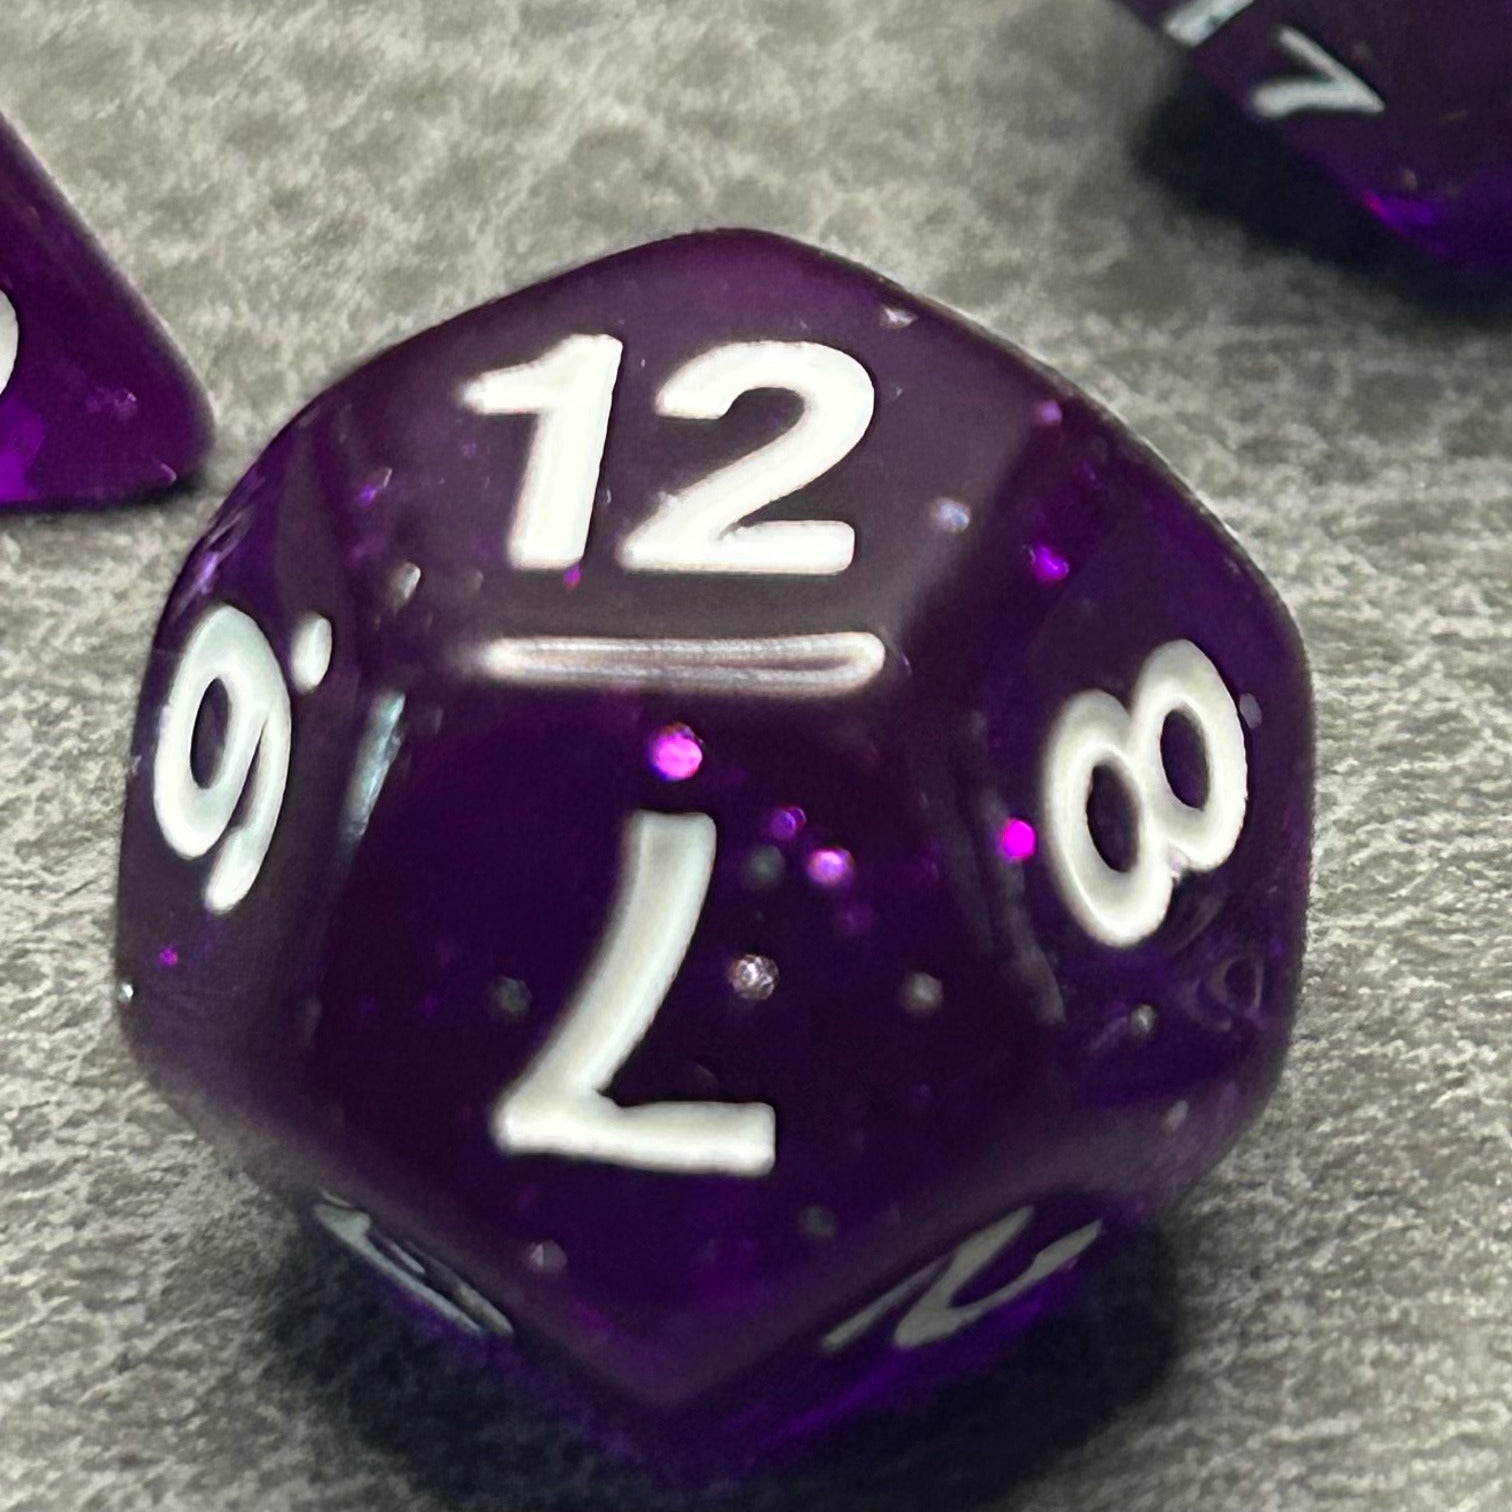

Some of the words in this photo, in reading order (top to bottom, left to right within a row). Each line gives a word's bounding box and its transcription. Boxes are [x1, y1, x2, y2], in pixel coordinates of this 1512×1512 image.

[459, 331, 876, 577] 12
[1043, 639, 1250, 948] 8
[492, 812, 776, 1176] 7
